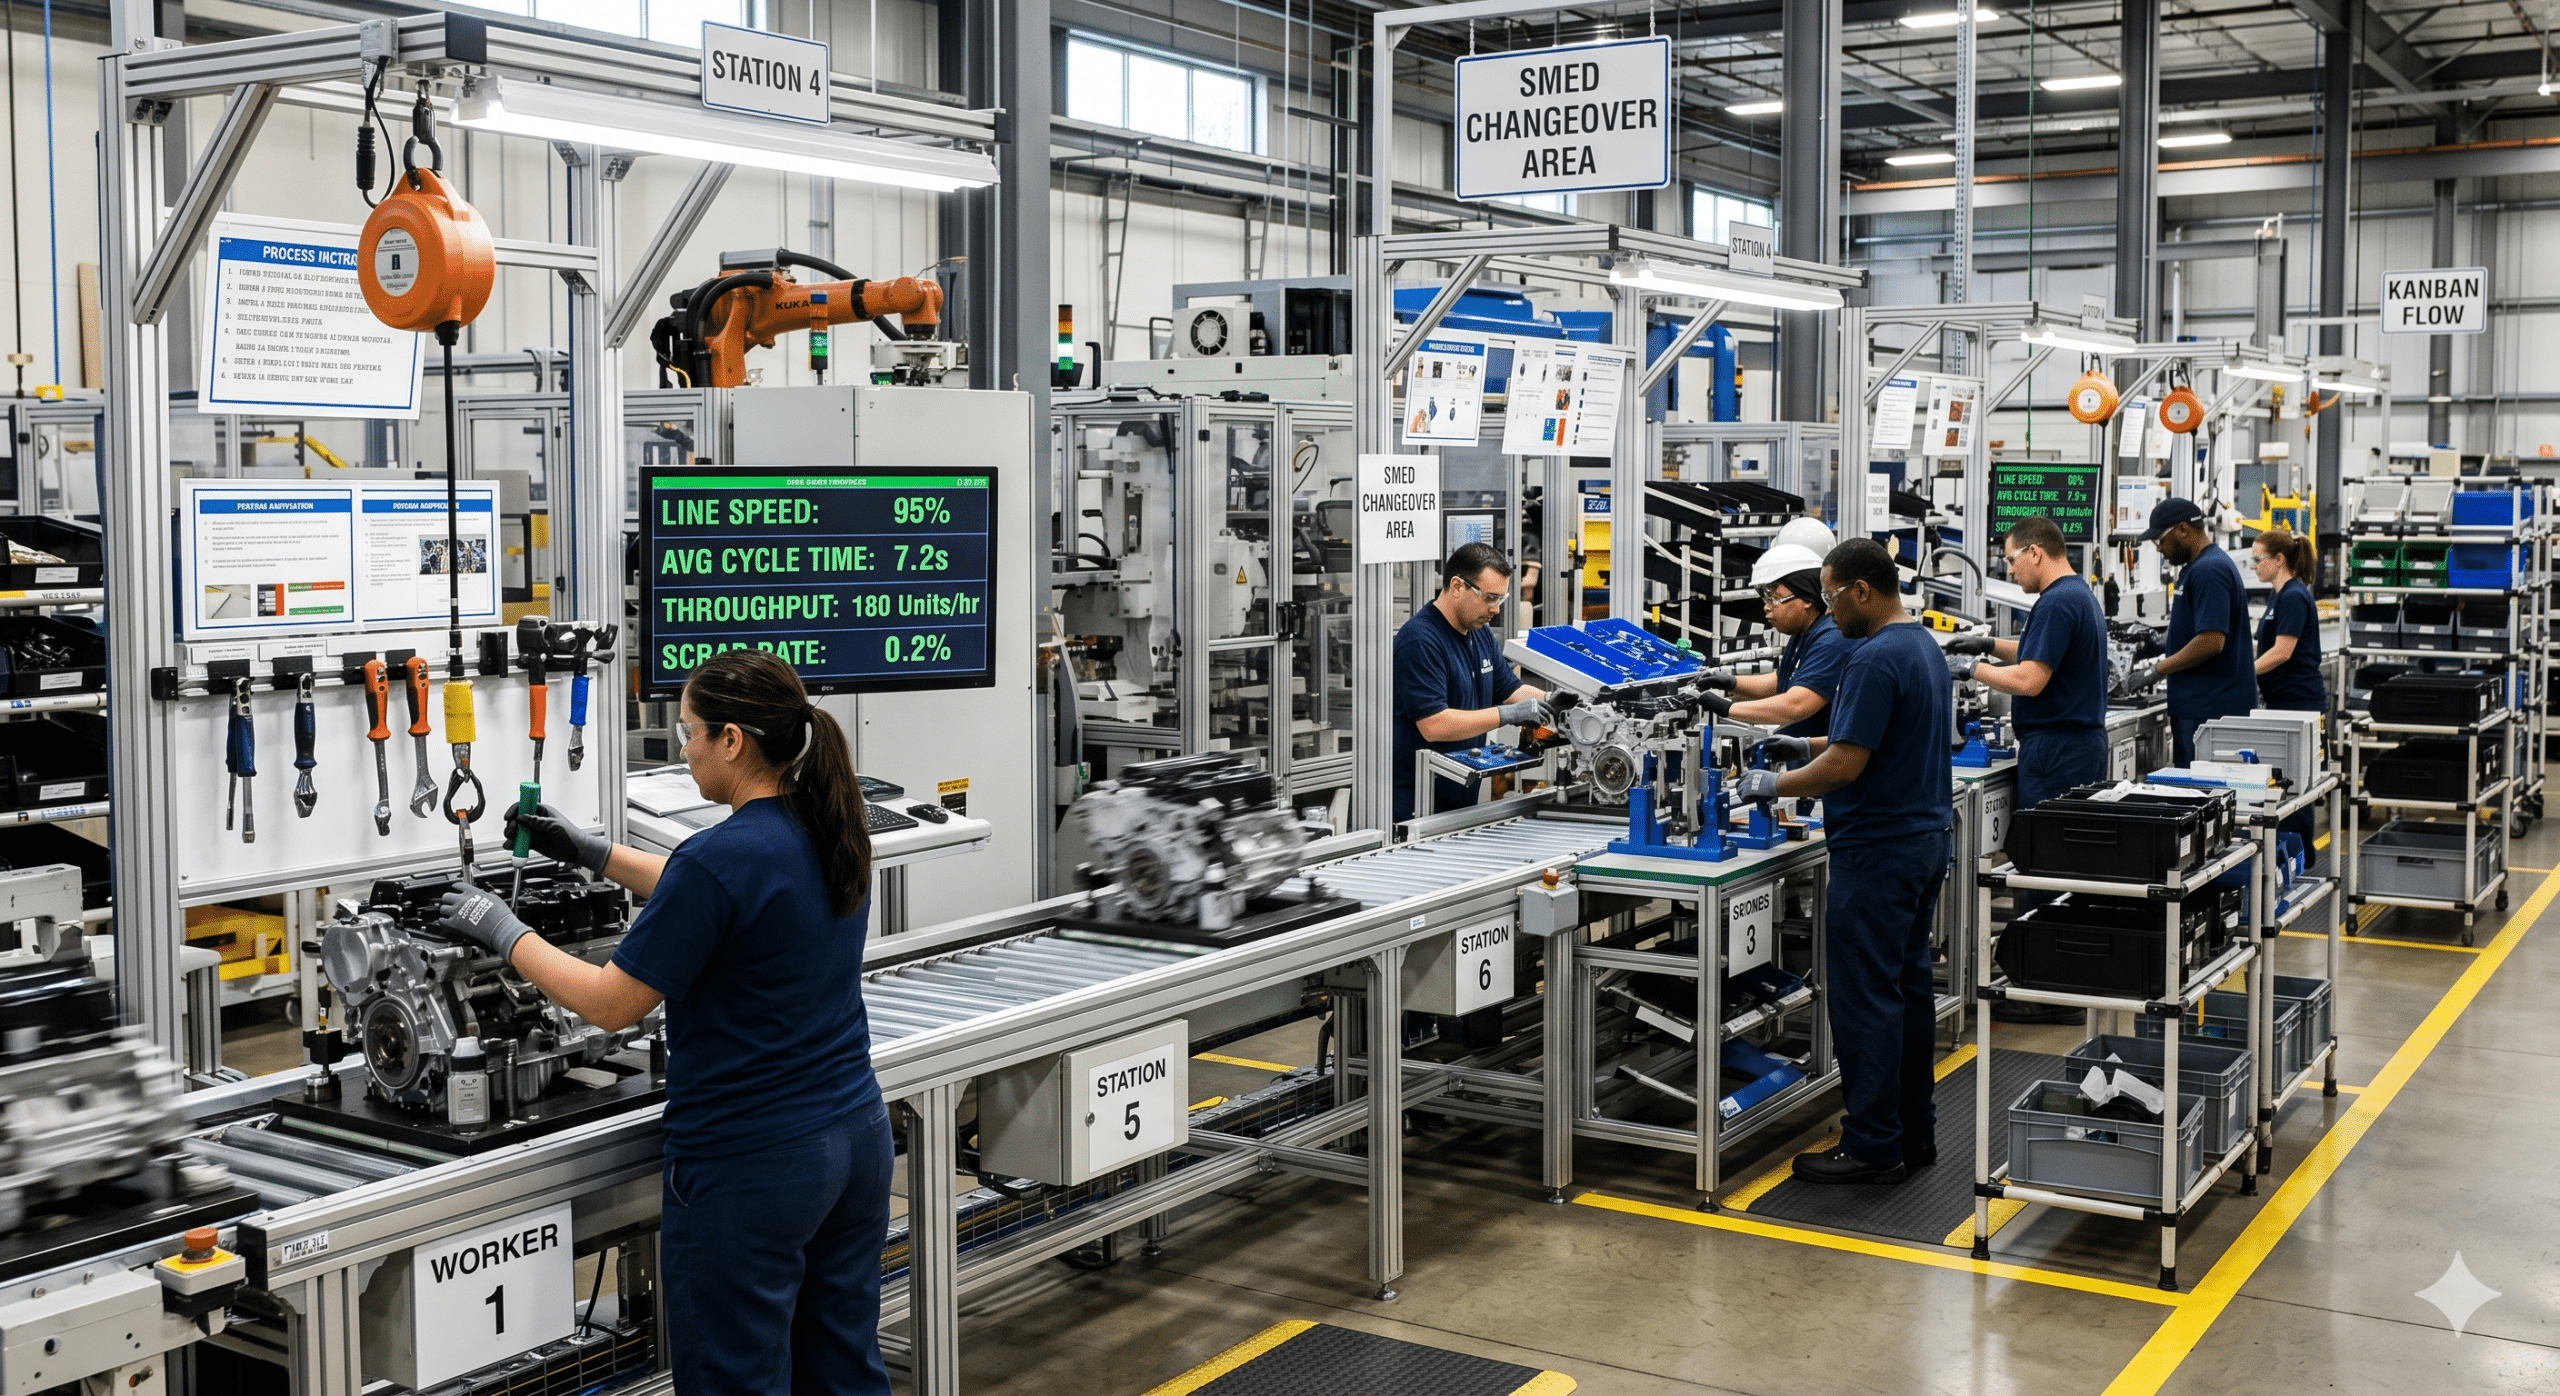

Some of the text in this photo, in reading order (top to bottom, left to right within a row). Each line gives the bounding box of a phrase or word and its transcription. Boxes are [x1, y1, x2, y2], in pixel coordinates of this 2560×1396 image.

[712, 50, 821, 96] STATION 4
[1520, 62, 1599, 97] SMED
[1466, 99, 1657, 143] CHANGEOVER
[1522, 145, 1597, 178] AREA
[263, 245, 315, 263] PROCESS
[1732, 237, 1771, 259] STATION 4
[2389, 278, 2478, 299] KANBAN
[776, 300, 810, 309] KUKA
[2403, 305, 2464, 325] FLOW
[1384, 466, 1415, 484] SMED
[662, 497, 951, 525] LINE SPEED: 95%
[1363, 493, 1436, 512] CHANGEOVER
[1386, 520, 1415, 539] AREA
[661, 544, 949, 574] AVG CYCLE TIME: 7.2s
[662, 593, 980, 623] THROUGHPUT: 180 Units/hr
[884, 633, 951, 663] 0.2%
[1461, 924, 1509, 955] STATION
[1746, 924, 1756, 955] 3
[1479, 958, 1491, 991] 6
[1097, 1058, 1165, 1097] STATION
[1124, 1100, 1140, 1140] 5
[430, 1223, 558, 1283] WORKER
[485, 1284, 504, 1335] 1
